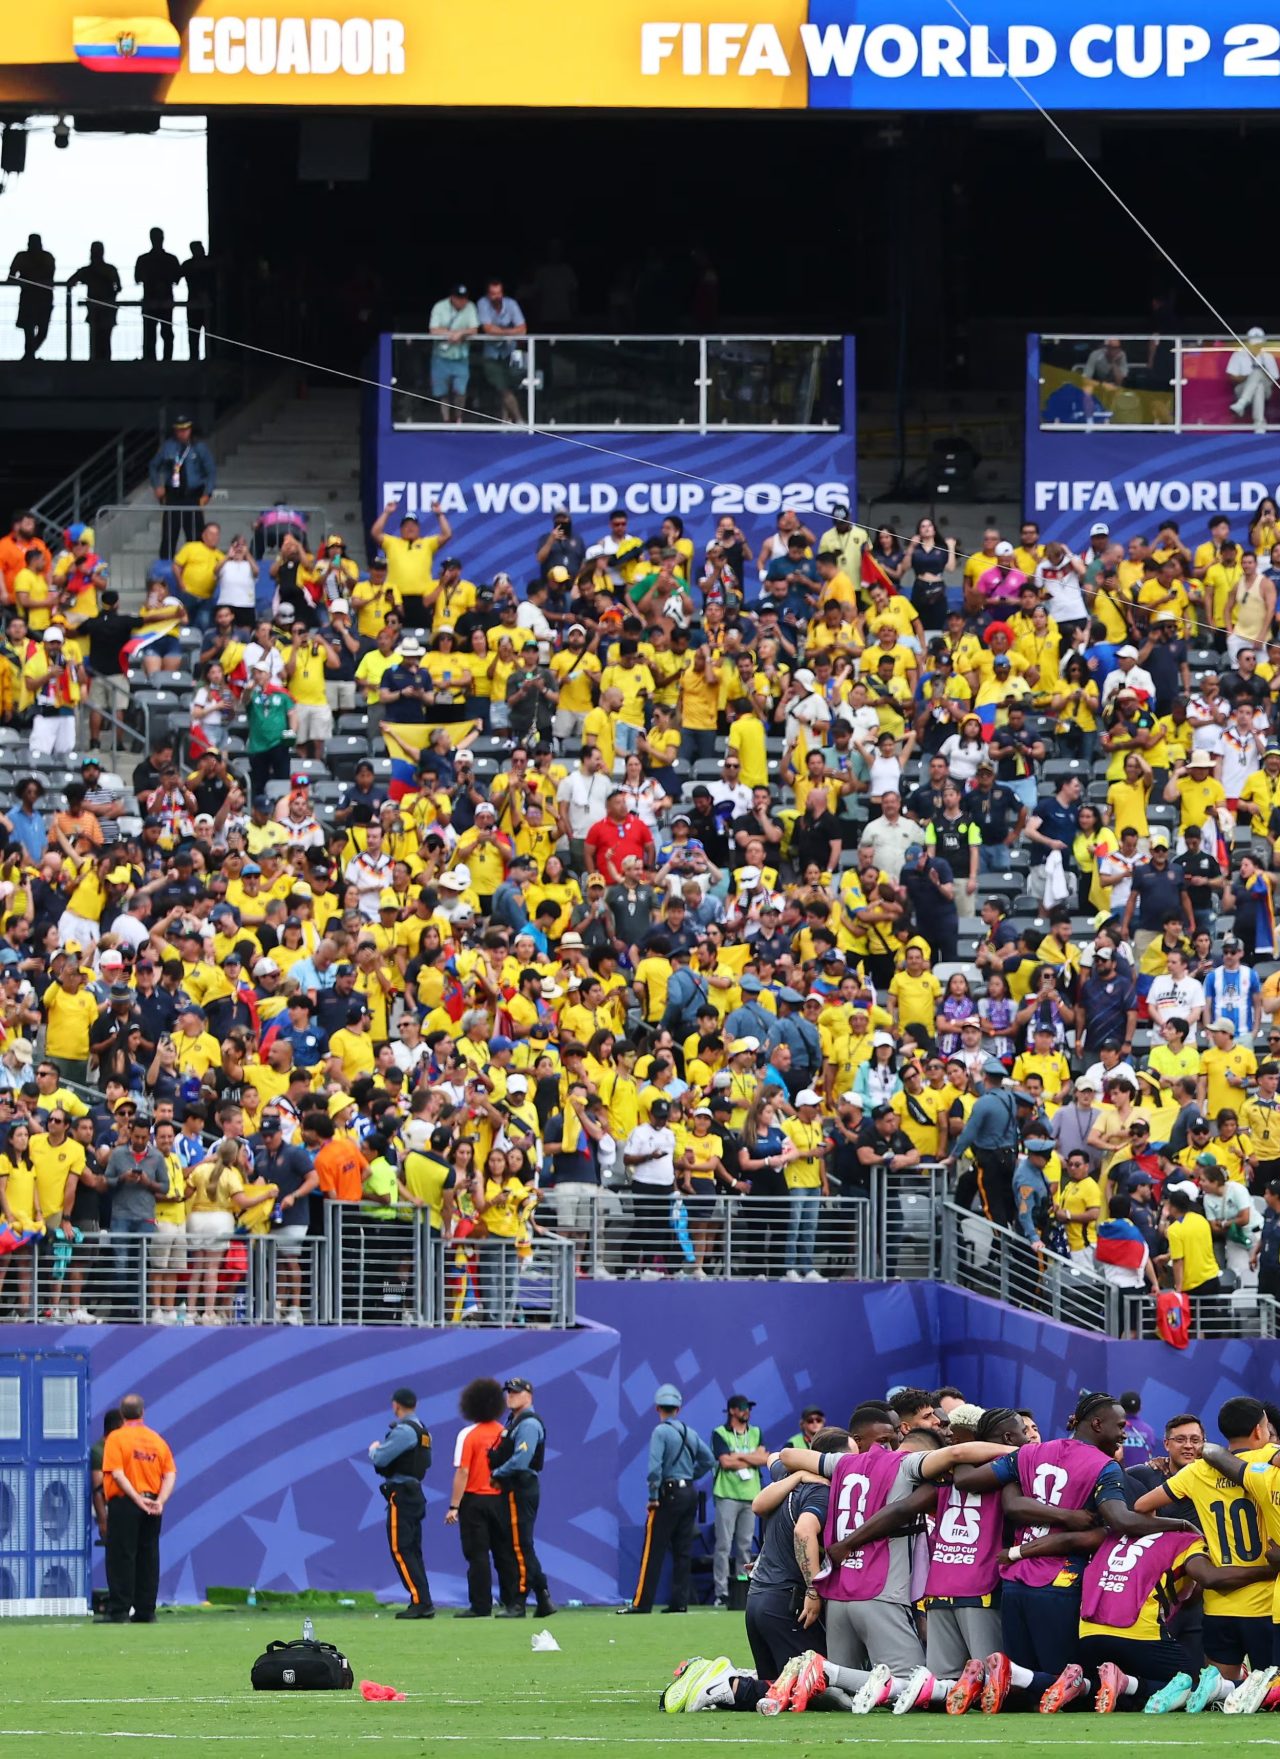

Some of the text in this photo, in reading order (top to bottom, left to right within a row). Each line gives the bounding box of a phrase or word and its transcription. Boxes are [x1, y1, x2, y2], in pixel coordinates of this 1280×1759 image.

[188, 17, 405, 75] ECUADOR
[640, 22, 791, 76] FIFA
[800, 23, 1057, 78] WORLD
[1068, 23, 1211, 78] CUP
[383, 482, 850, 514] FIFA WORLD CUP 2026
[1034, 480, 1119, 512] FIFA
[1124, 481, 1269, 512] WORLD
[951, 1528, 969, 1538] FIFA
[1209, 1497, 1263, 1565] 10
[932, 1550, 975, 1565] 2026
[935, 1542, 978, 1554] WORLD CUP
